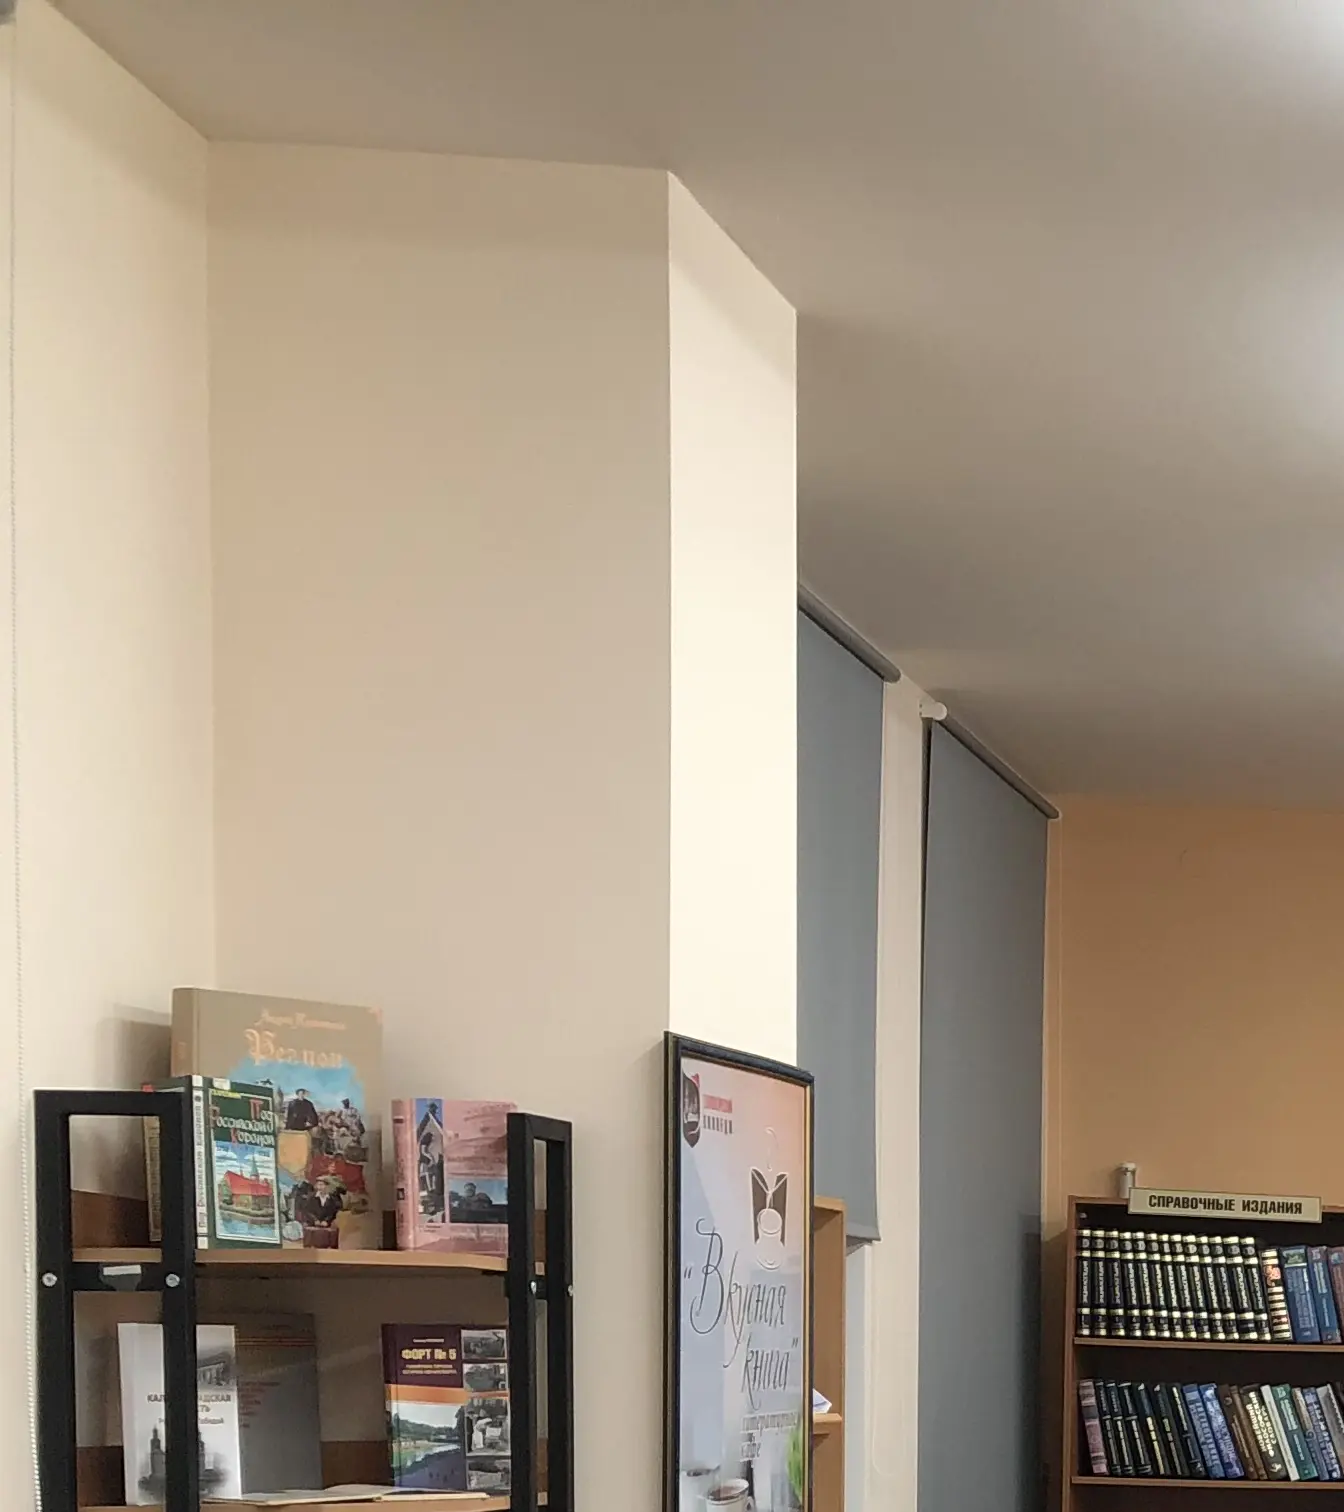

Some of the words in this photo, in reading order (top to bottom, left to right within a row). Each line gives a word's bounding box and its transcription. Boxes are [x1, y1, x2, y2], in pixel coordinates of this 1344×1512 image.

[1148, 1194, 1236, 1212] СПРАВОЧНЫЕ
[1241, 1199, 1303, 1215] ИЗДАНИЯ
[401, 1349, 431, 1360] ФОРТ
[1246, 1403, 1267, 1452] НОВЕЙШИЙ
[1249, 1391, 1275, 1458] ФИЛОСОФСКИЙ
